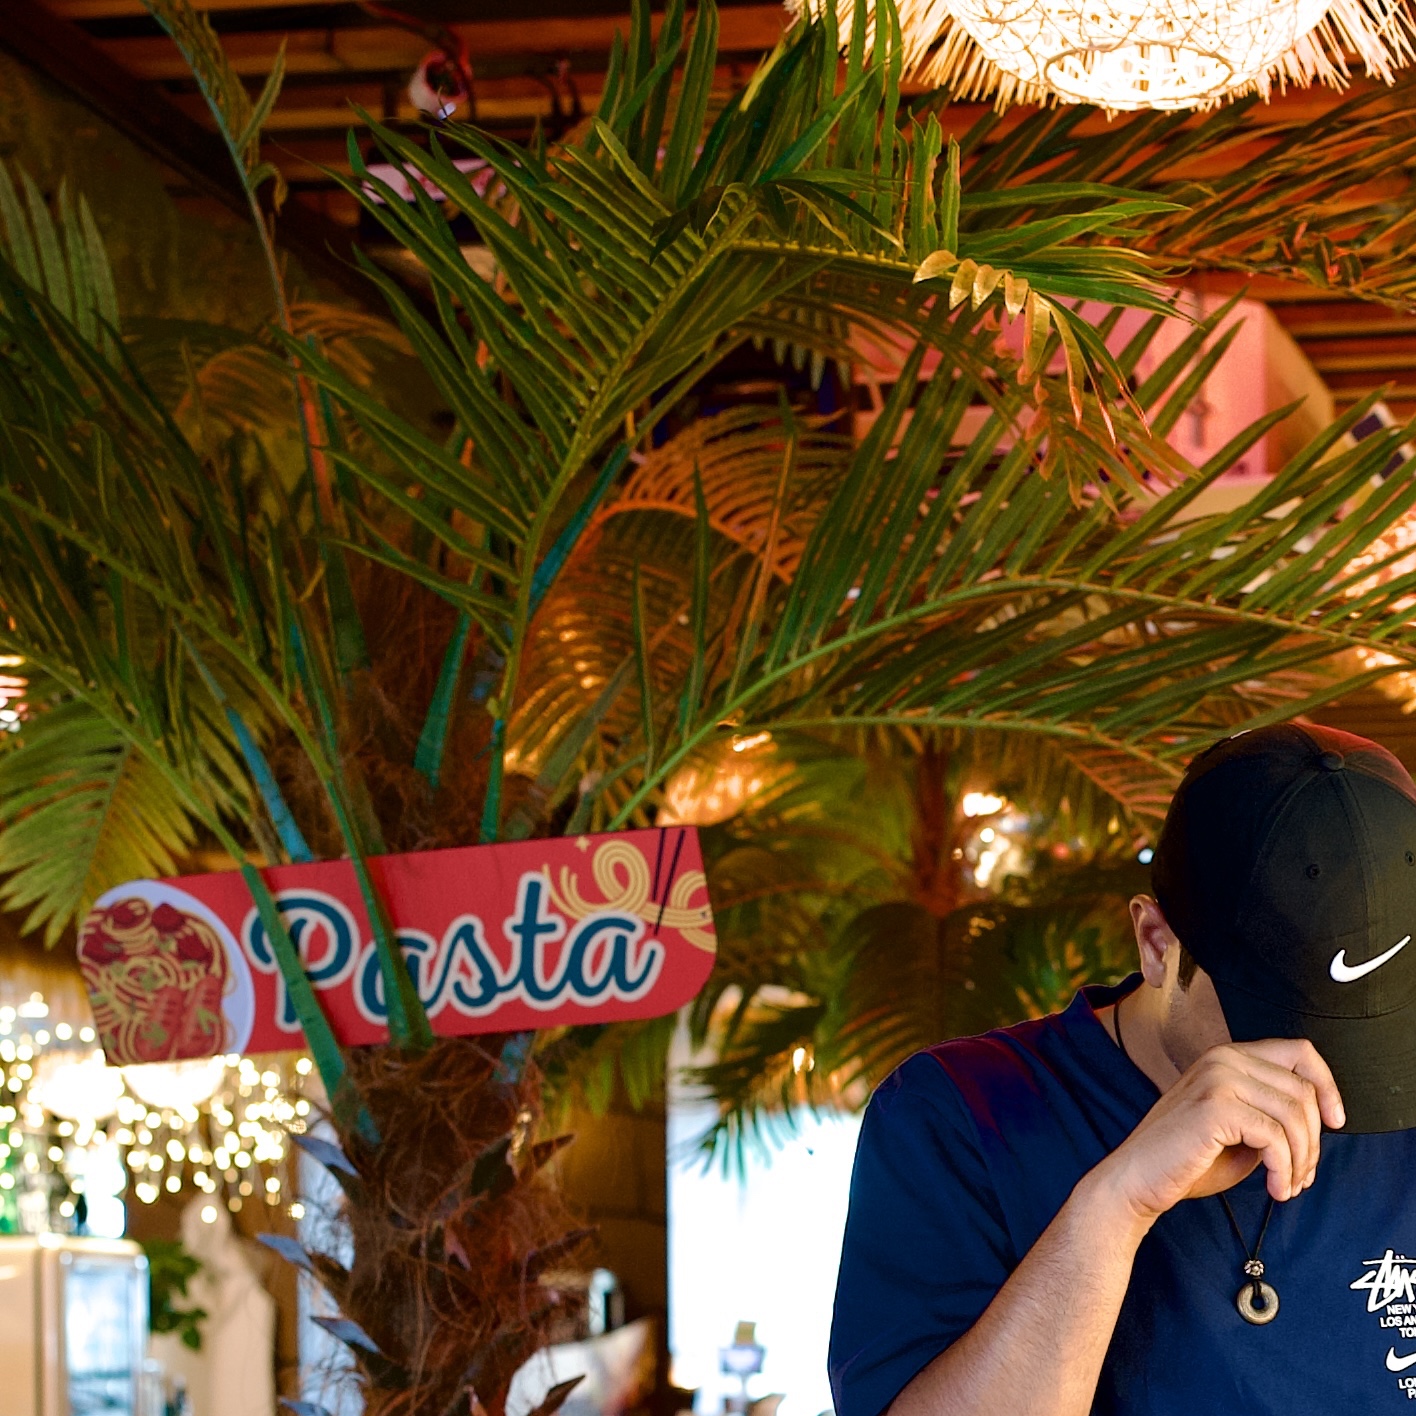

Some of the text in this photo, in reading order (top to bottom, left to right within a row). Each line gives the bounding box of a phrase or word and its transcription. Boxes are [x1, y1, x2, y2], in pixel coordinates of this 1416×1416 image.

[241, 873, 664, 1031] Pasta
[1386, 1303, 1412, 1315] NEW
[1380, 1316, 1403, 1328] LOS
